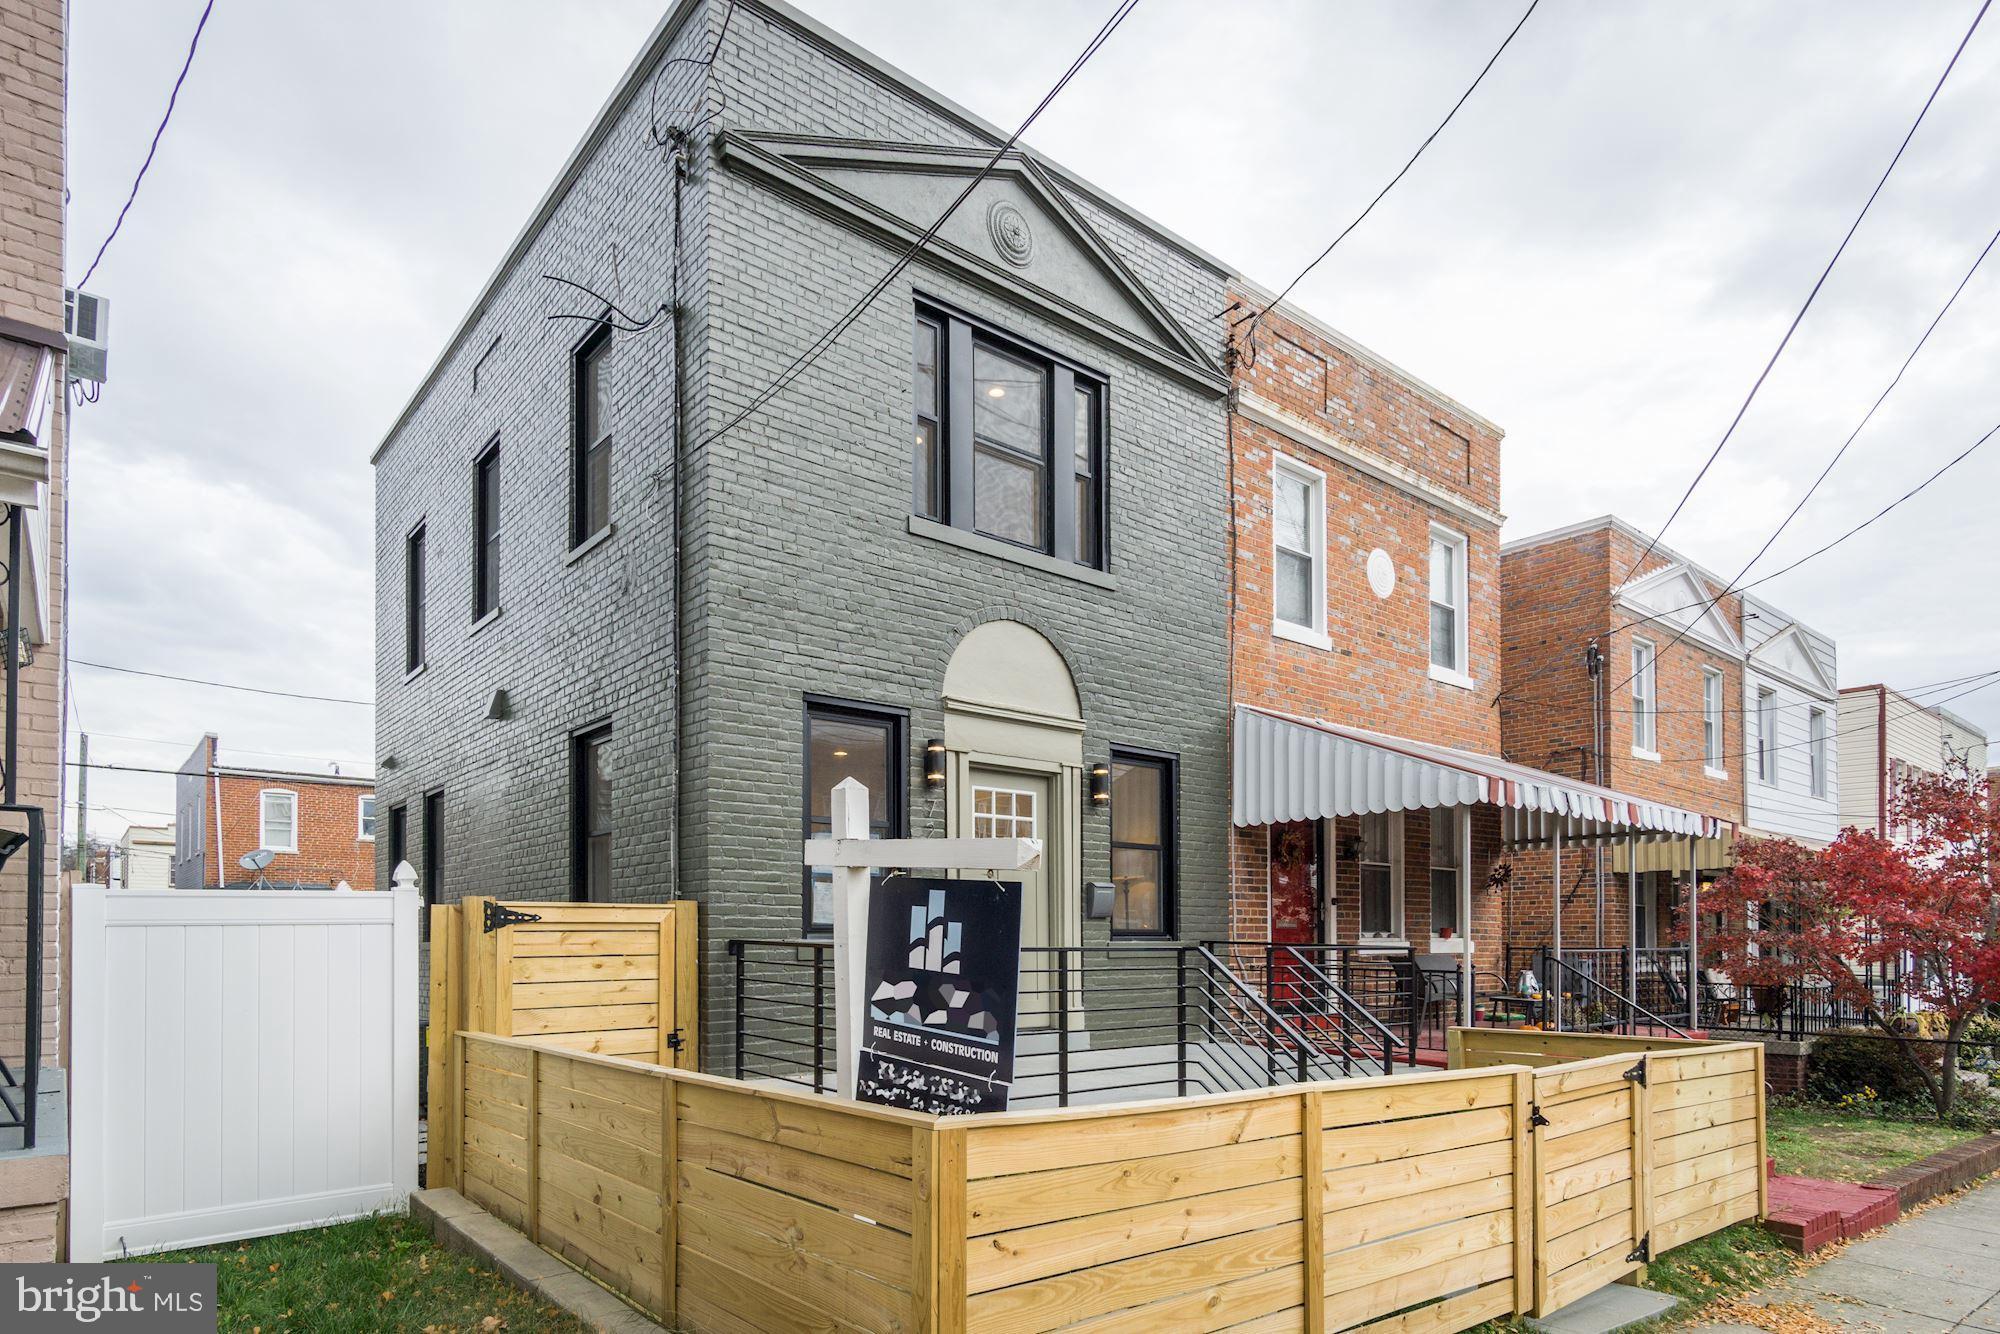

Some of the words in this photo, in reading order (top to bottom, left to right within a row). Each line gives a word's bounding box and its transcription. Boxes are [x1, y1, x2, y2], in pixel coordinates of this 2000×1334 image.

[873, 1026, 891, 1040] REAL
[894, 1030, 921, 1046] ESTATE
[931, 1038, 999, 1064] CONSTRUCTION
